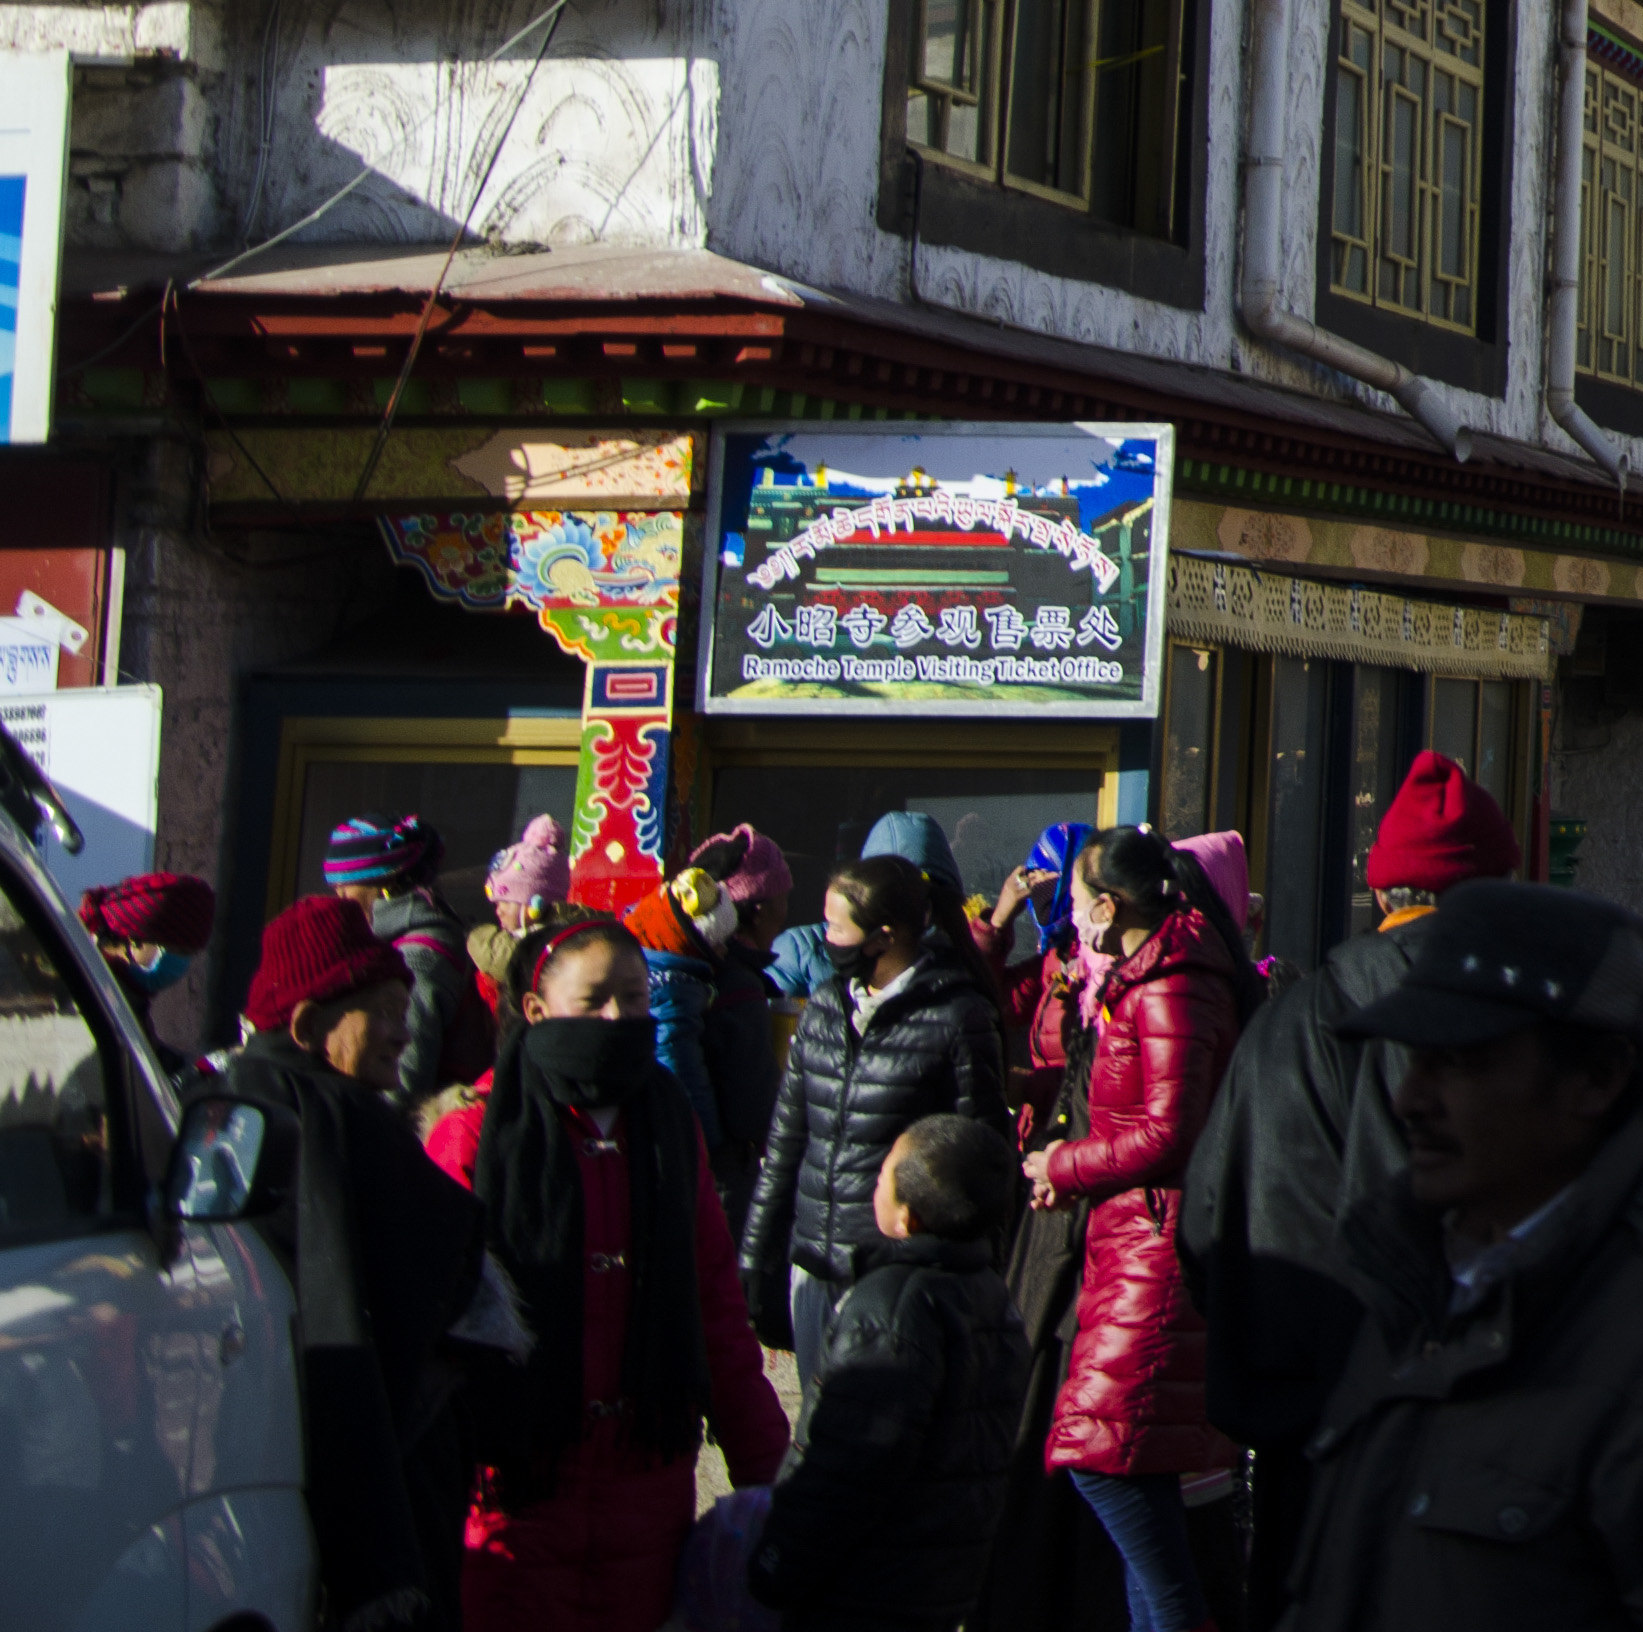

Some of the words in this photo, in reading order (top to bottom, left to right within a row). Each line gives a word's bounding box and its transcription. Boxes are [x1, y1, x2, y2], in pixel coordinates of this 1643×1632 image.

[747, 603, 1123, 651] 小昭寺参观售票处
[743, 654, 840, 681] Ramoche
[841, 655, 915, 684] Temple
[916, 656, 996, 686] Visiting
[996, 656, 1060, 682] Ticket
[1060, 658, 1123, 683] Office
